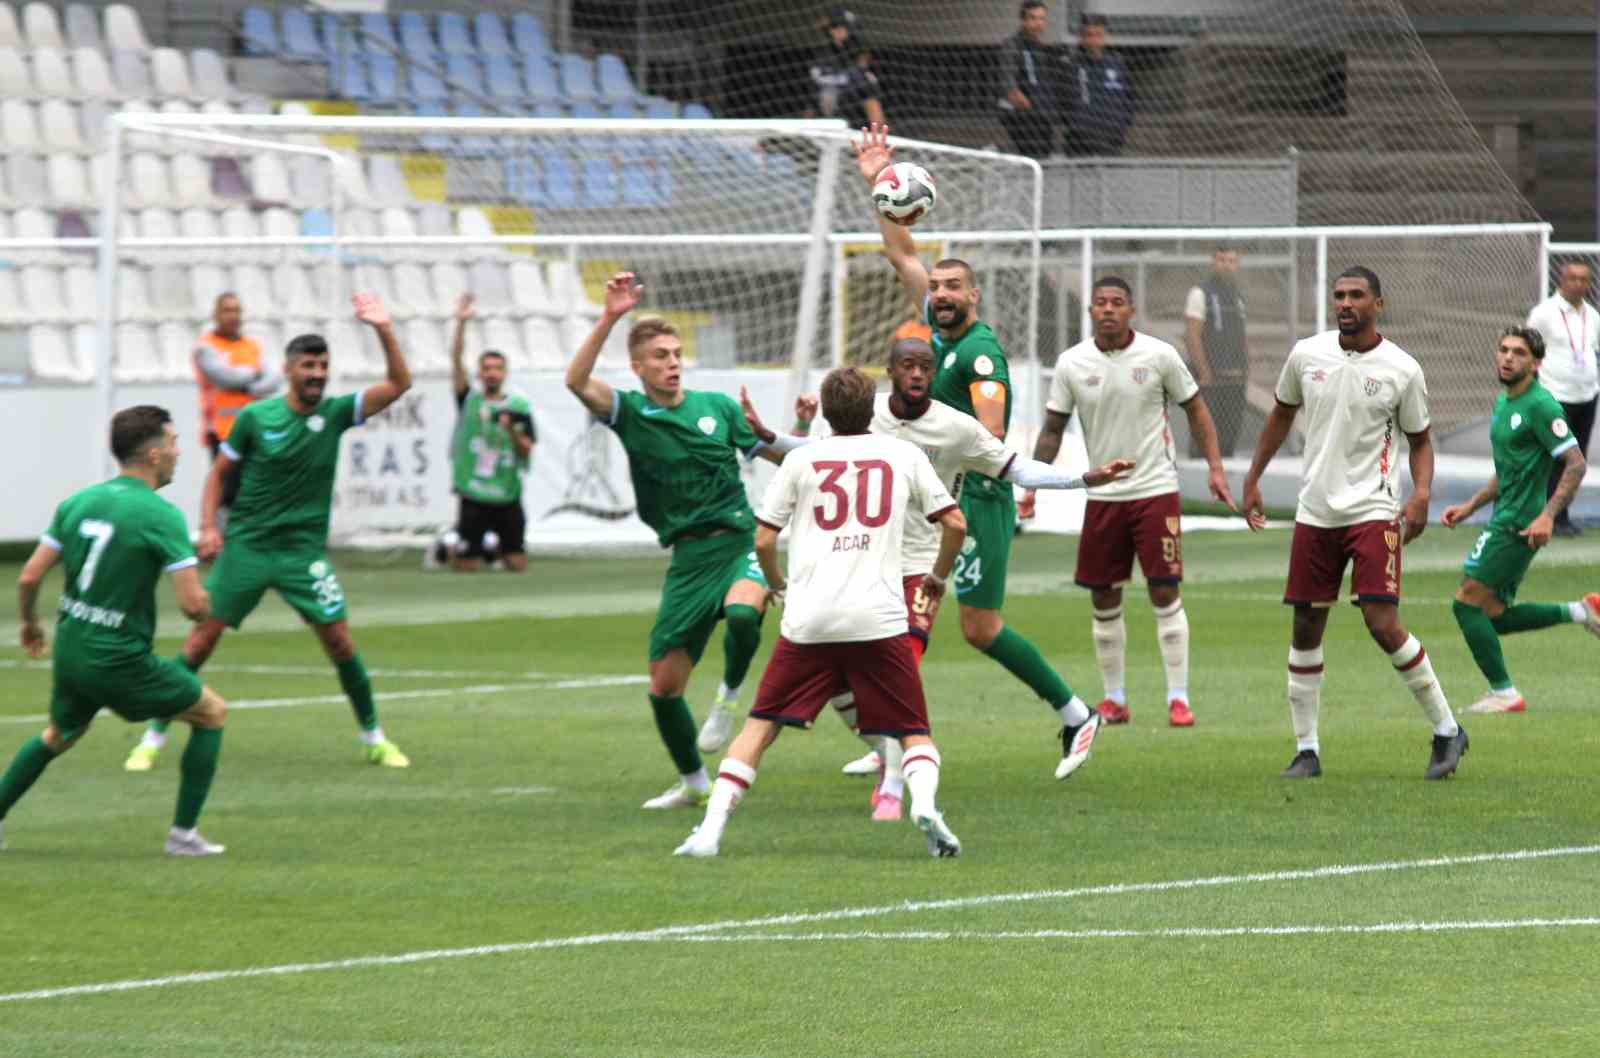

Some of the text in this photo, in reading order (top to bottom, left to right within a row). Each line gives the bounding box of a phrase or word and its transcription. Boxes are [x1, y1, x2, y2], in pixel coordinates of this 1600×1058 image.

[812, 459, 894, 531] 30
[78, 518, 114, 592] 7
[832, 534, 871, 552] ACAR
[953, 554, 982, 585] 24
[1385, 553, 1397, 579] 4
